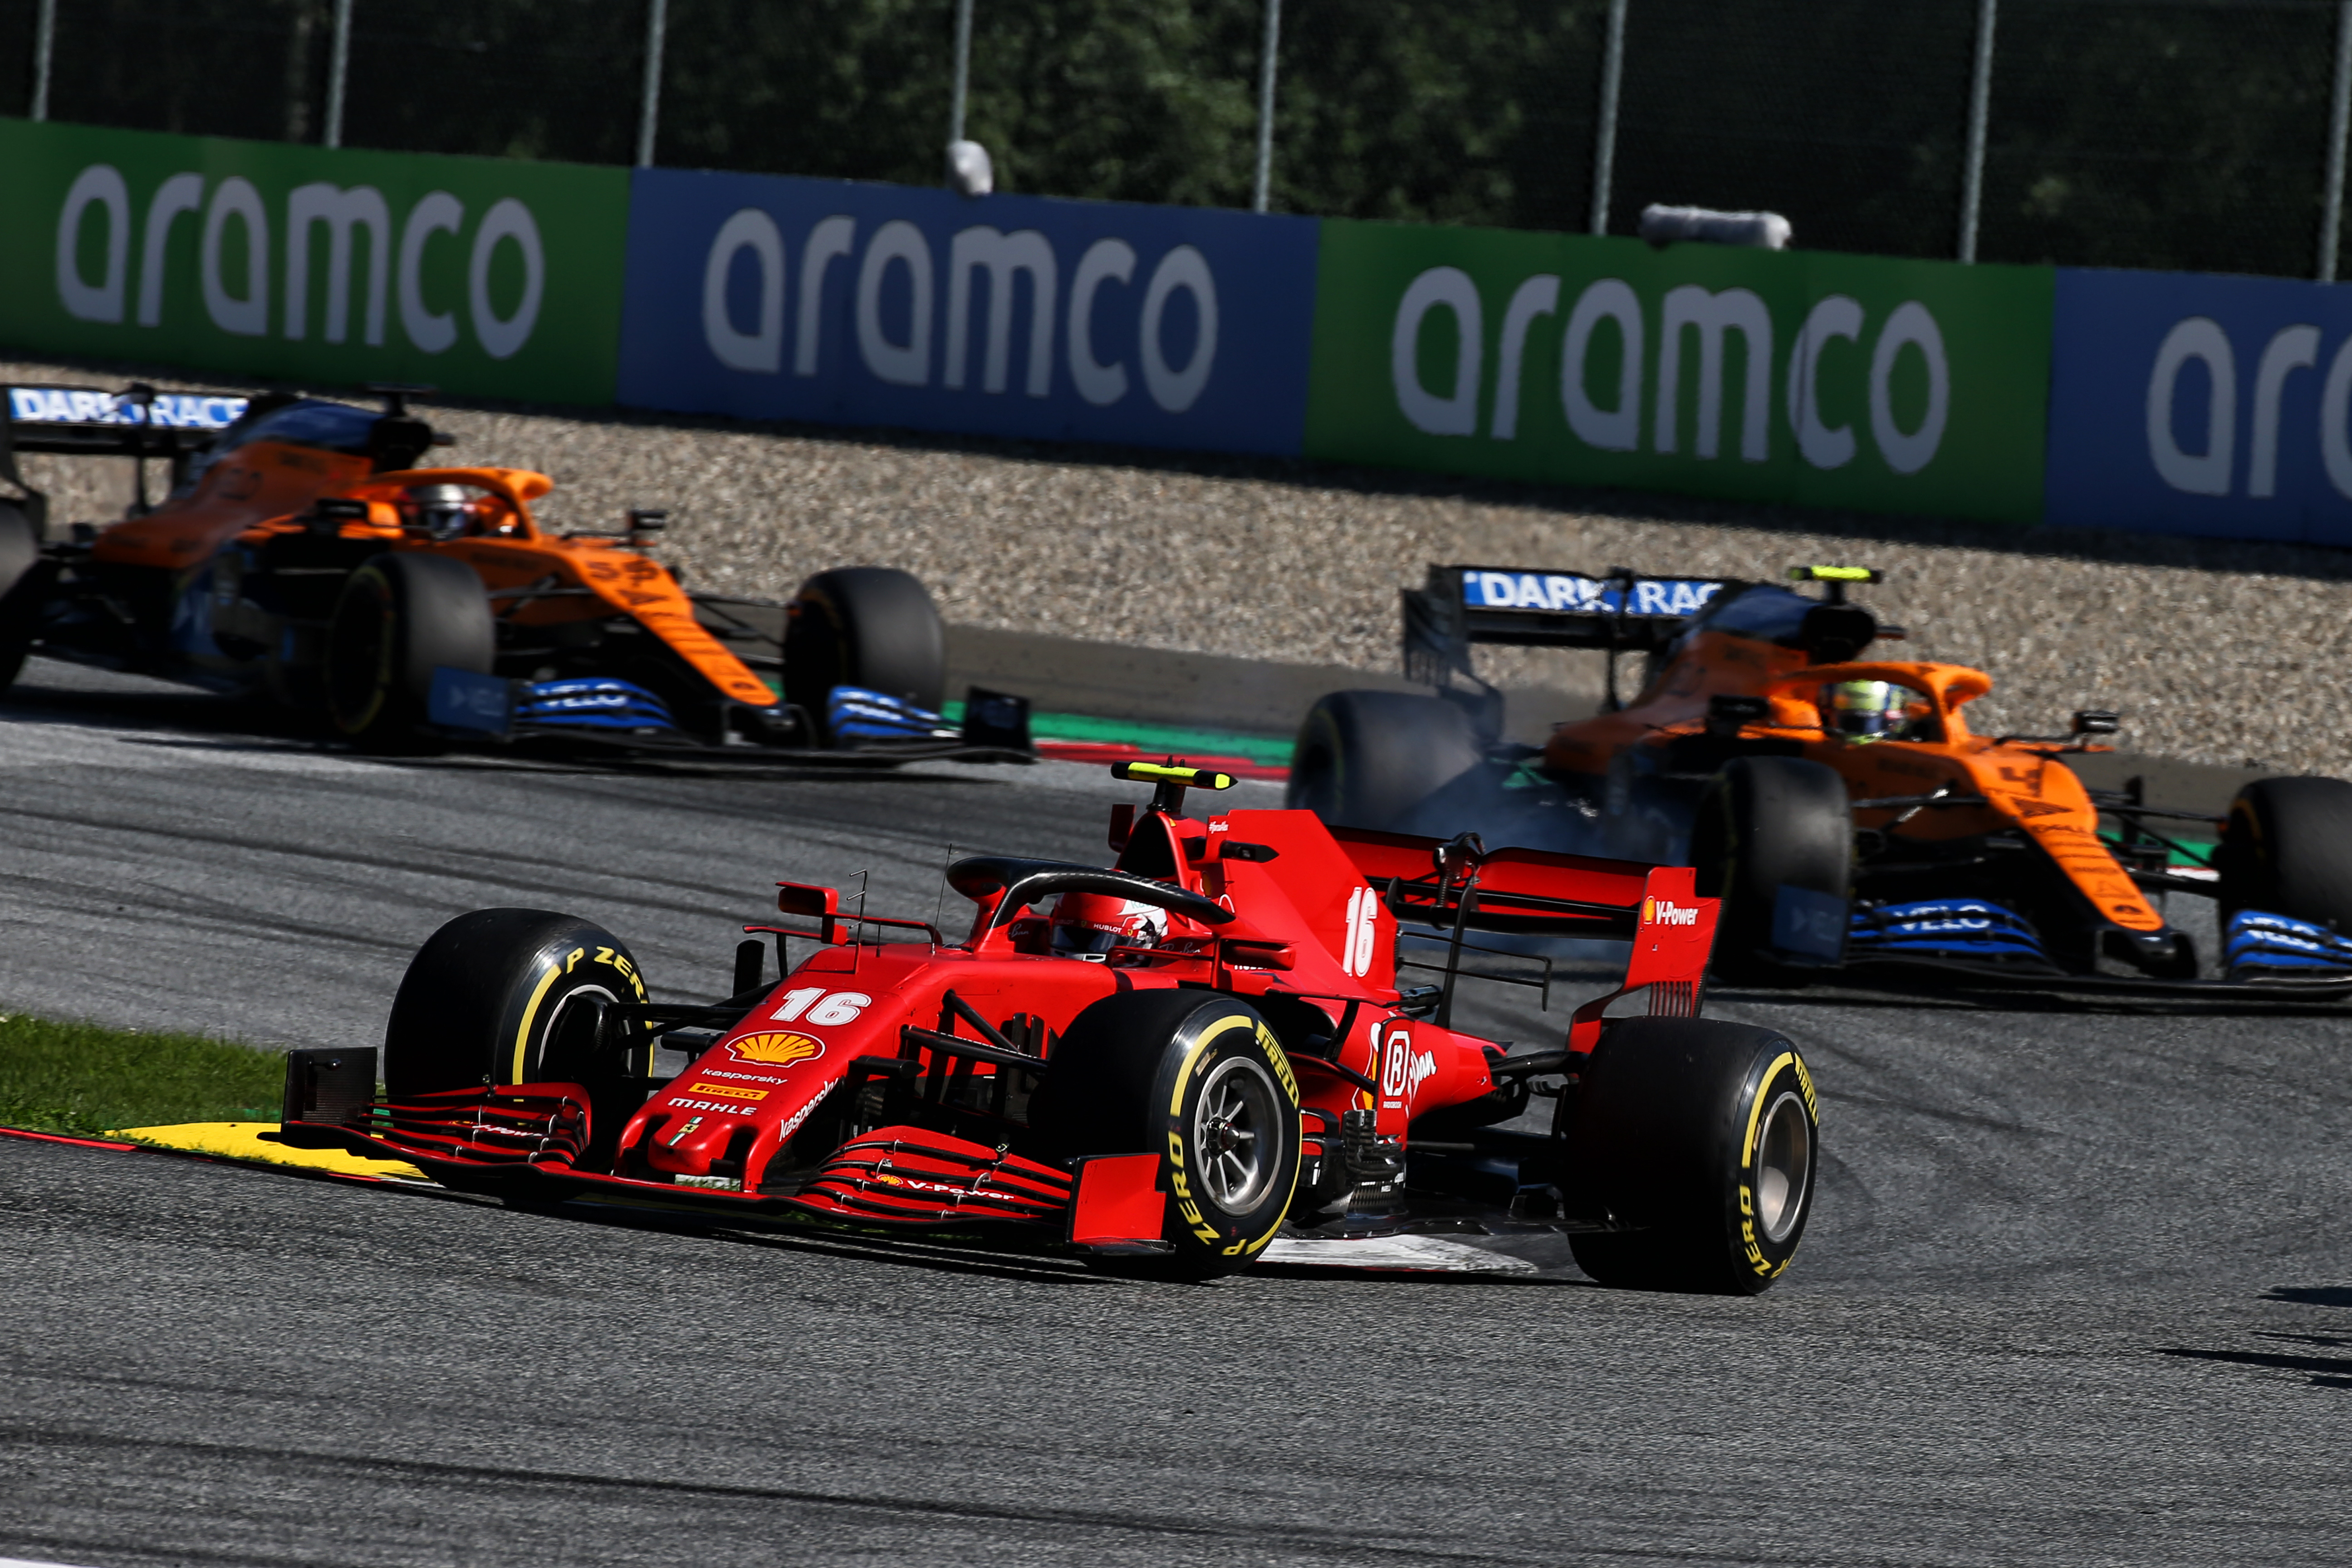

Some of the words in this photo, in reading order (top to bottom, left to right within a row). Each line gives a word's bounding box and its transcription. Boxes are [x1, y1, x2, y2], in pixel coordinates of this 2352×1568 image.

[57, 164, 545, 360] aramco
[702, 208, 1219, 413] aramco
[1392, 265, 1950, 475] aramco
[1093, 923, 1123, 933] HUBLOT
[1342, 886, 1379, 978] 16
[1655, 901, 1699, 926] V-Power
[566, 947, 584, 974] P
[593, 946, 649, 1004] ZER
[769, 987, 872, 1027] 16
[696, 1085, 761, 1098] PIRELLI
[701, 1068, 788, 1085] kaspersky
[1255, 1019, 1300, 1110] PIRELLI
[1794, 1052, 1819, 1127] PIRELLI
[667, 1097, 758, 1116] MAHLE
[907, 1180, 1014, 1200] V-Power
[1168, 1131, 1221, 1246] ZERO
[1221, 1239, 1247, 1255] P
[1739, 1184, 1773, 1277] ZERO
